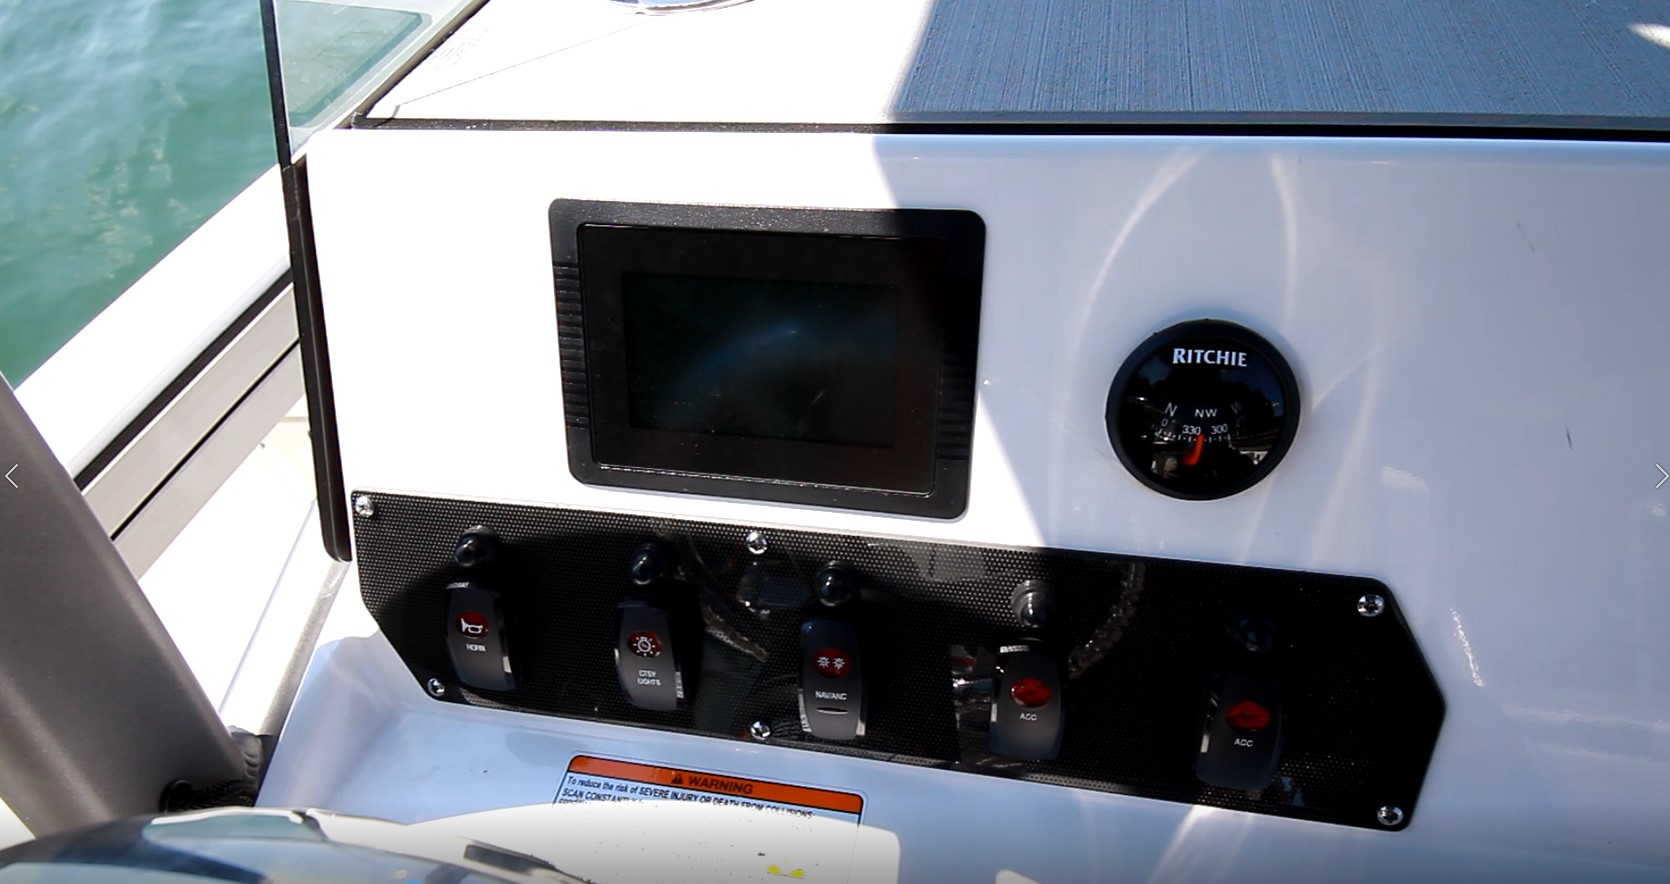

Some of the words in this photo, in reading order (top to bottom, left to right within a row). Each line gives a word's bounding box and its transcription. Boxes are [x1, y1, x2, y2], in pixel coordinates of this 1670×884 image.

[1172, 348, 1248, 367] RITCHIE
[1165, 402, 1177, 417] N
[1194, 408, 1218, 418] NW
[1182, 424, 1201, 435] 330
[1210, 423, 1228, 434] 300
[465, 643, 486, 652] HORN
[1019, 712, 1038, 721] ACC
[1233, 738, 1254, 747] ACC
[567, 776, 577, 785] To
[577, 778, 602, 788] reduce
[602, 781, 614, 791] the
[615, 783, 628, 793] risk
[630, 785, 640, 794] of
[639, 786, 670, 799] SEVERE
[671, 791, 699, 802] INJURY
[700, 795, 712, 804] OR
[713, 797, 739, 807] DEATH
[688, 775, 754, 795] WARNING
[562, 787, 583, 798] SCAN
[585, 791, 637, 802] CONSTANT
